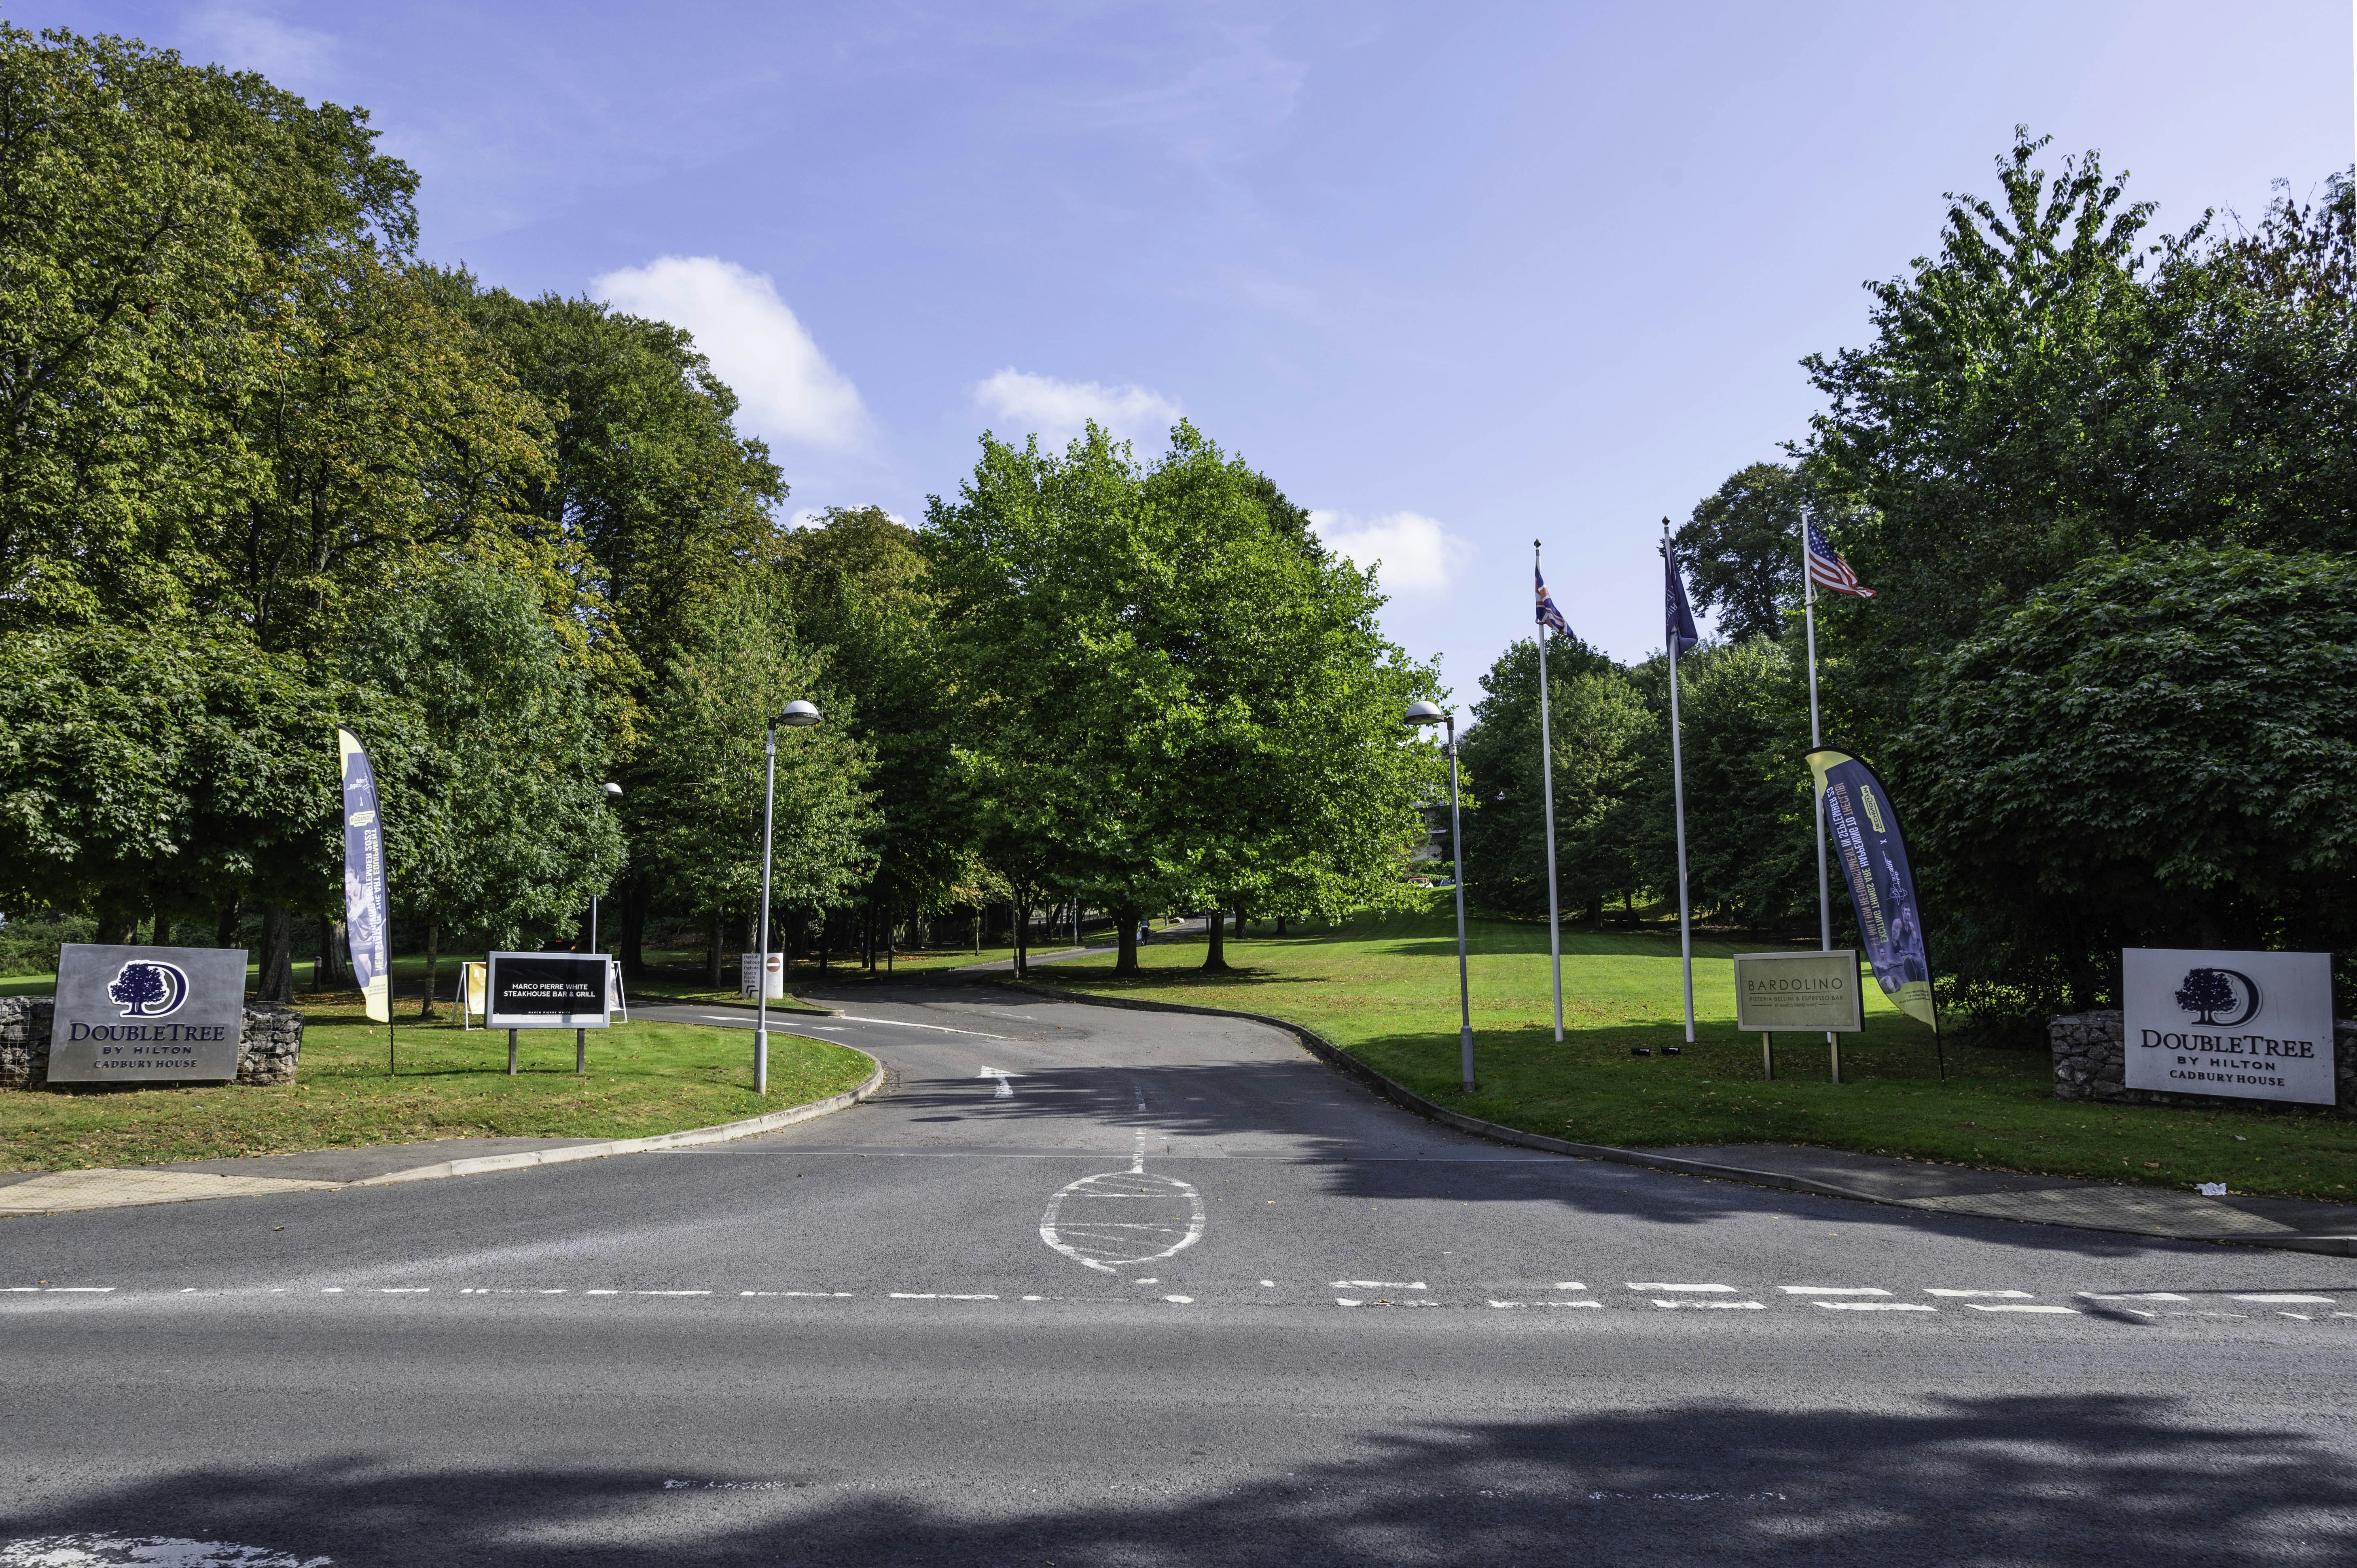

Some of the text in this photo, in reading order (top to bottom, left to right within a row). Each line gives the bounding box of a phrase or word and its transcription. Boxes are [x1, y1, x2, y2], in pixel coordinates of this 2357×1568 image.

[1748, 978, 1842, 990] BARDOLINO
[103, 1046, 192, 1054] BY HILTON
[94, 1059, 198, 1068] CADBURY HOUSE
[2177, 1056, 2276, 1071] BY HILTON
[2170, 1070, 2285, 1086] CADBURY HOUSE
